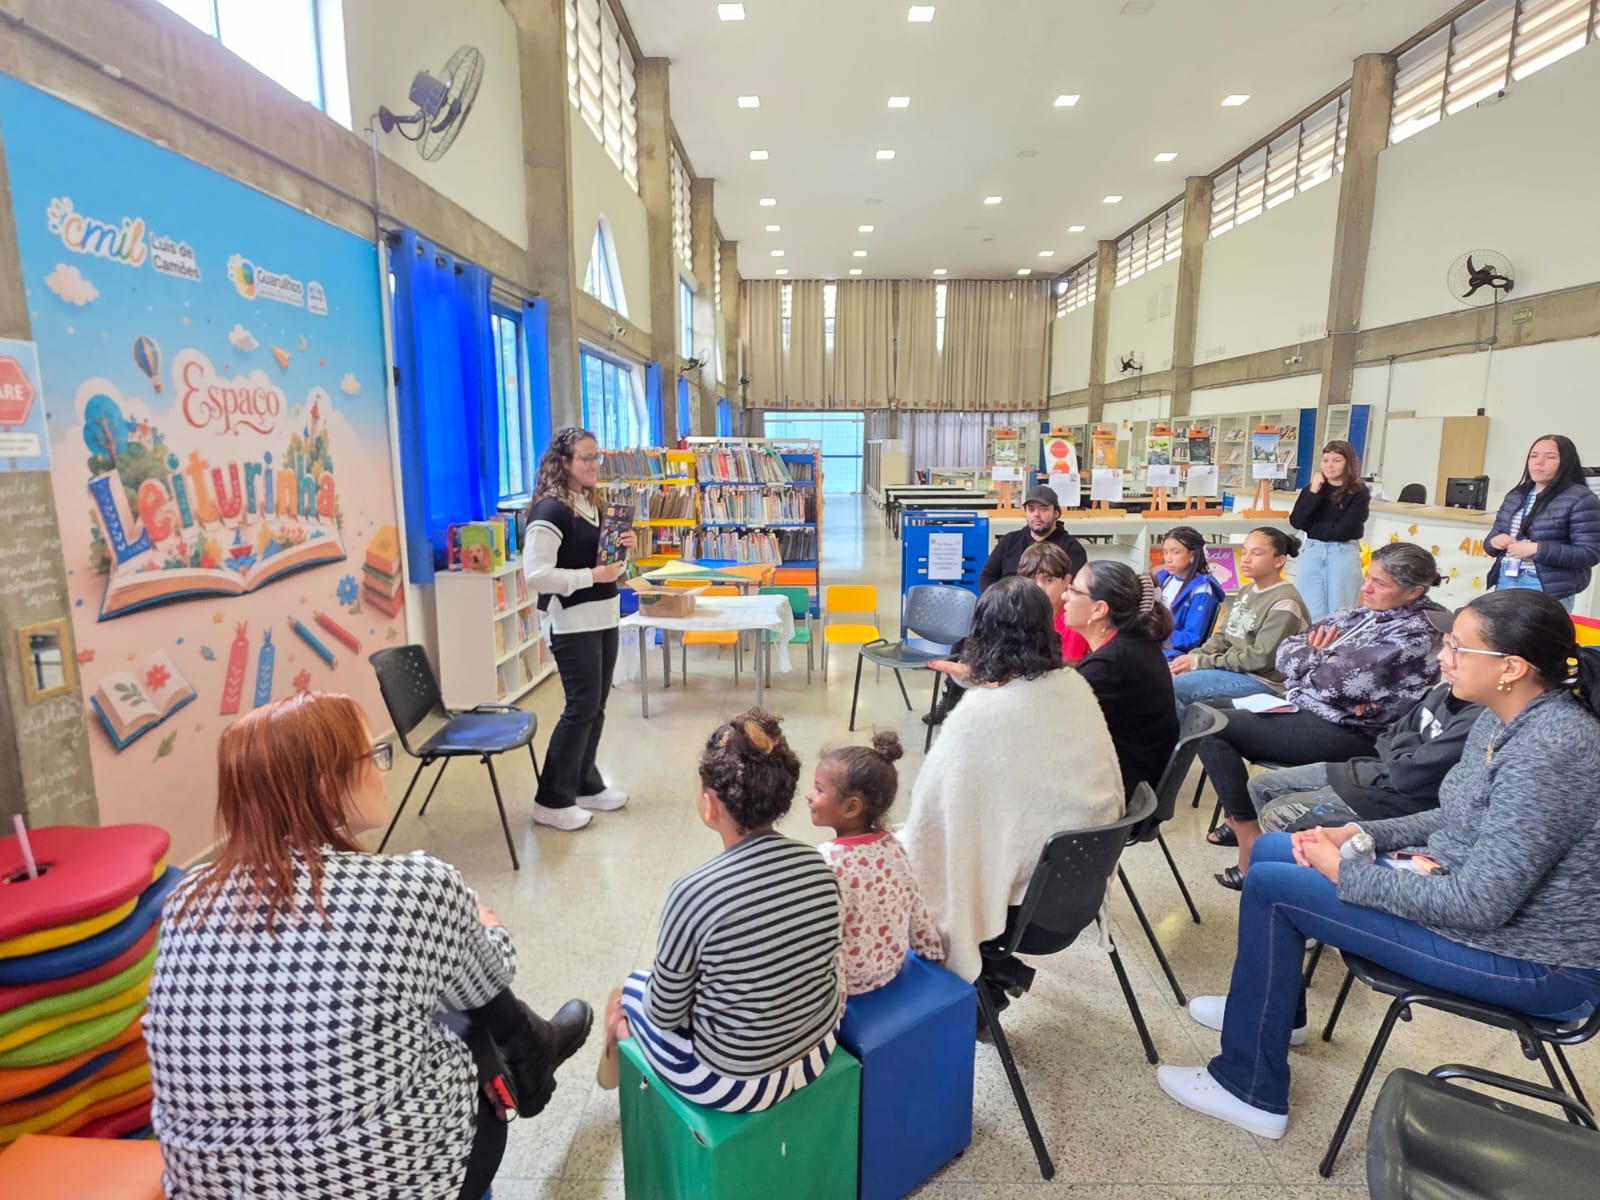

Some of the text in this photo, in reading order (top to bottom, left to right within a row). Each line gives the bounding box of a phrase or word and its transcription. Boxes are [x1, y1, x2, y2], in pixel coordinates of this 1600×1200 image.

[63, 218, 146, 264] cmil
[179, 244, 193, 260] de
[257, 269, 303, 295] Guarulhos
[0, 384, 25, 401] ARE
[182, 361, 280, 434] Espaço
[88, 449, 336, 565] Leiturinha
